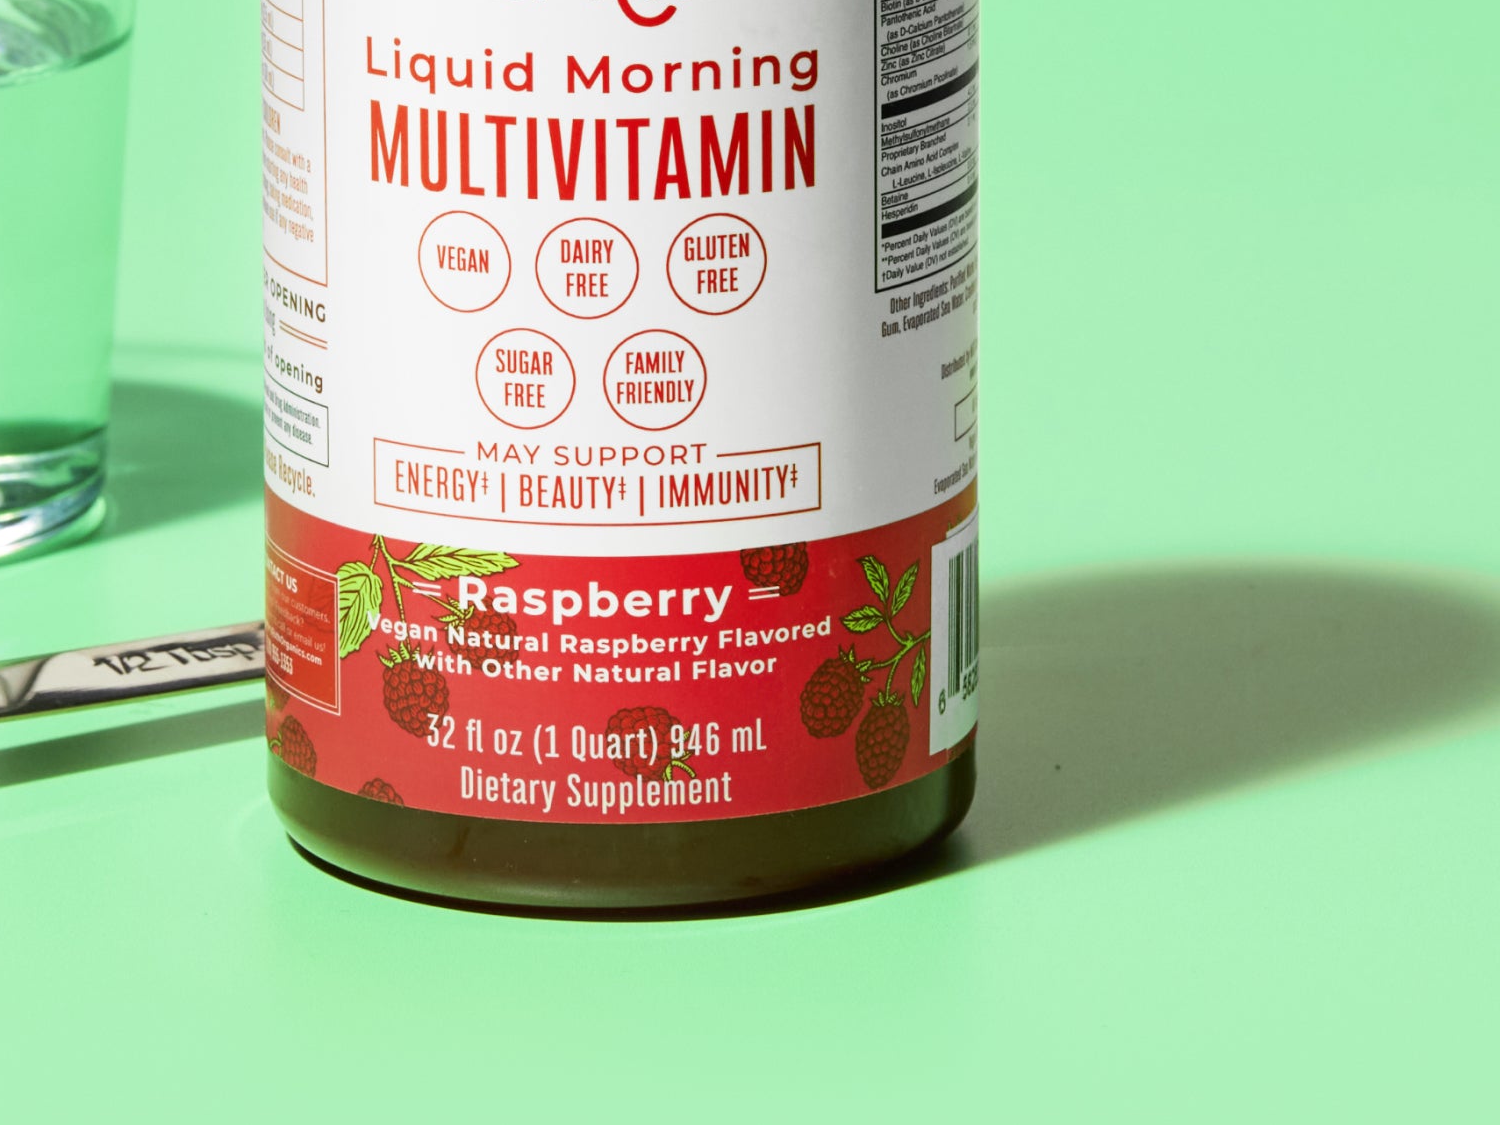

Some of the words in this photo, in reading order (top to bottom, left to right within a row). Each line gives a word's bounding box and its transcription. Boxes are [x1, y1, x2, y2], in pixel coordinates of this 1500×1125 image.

[881, 1, 901, 12] Biotin
[881, 10, 921, 27] Pantothenic
[881, 43, 908, 57] Choline
[910, 39, 920, 51] (as
[887, 31, 898, 42] (as
[365, 34, 534, 95] Liquid
[566, 45, 819, 95] Morning
[881, 60, 896, 71] Zinc
[899, 56, 910, 68] (as
[881, 69, 917, 86] Chromium
[887, 89, 898, 101] (as
[881, 118, 907, 132] Inositol
[369, 98, 817, 202] MULTIVITAMIN
[881, 145, 919, 161] Proprietary
[307, 159, 311, 173] a
[881, 163, 902, 177] Chain
[904, 157, 924, 171] Amino
[881, 193, 908, 206] Betaine
[881, 203, 918, 220] Hesperidin
[436, 244, 491, 274] VEGAN
[559, 238, 615, 265] DAIRY
[683, 232, 751, 262] GLUTEN
[696, 267, 739, 295] FREE
[905, 263, 924, 274] Value
[565, 273, 610, 298] FREE
[270, 277, 326, 323] OPENING
[890, 296, 911, 314] Other
[903, 303, 939, 331] Evaporated
[275, 354, 323, 394] opening
[495, 348, 554, 376] SUGAR
[625, 349, 686, 375] FAMILY
[504, 382, 546, 409] FREE
[616, 379, 695, 405] FRIENDLY
[477, 440, 541, 464] MAY
[553, 442, 708, 467] SUPPORT
[279, 455, 316, 498] Recycle.
[286, 574, 298, 594] US
[457, 575, 733, 625] Raspberry
[366, 610, 438, 642] Vegan
[446, 625, 549, 653] Natural
[560, 632, 709, 658] Raspberry
[718, 615, 832, 651] Flavored
[414, 652, 473, 676] with
[483, 657, 563, 683] Other
[572, 662, 682, 683] Natural
[691, 653, 778, 680] Flavor
[939, 688, 946, 715] 6
[426, 712, 456, 751] 32
[467, 720, 484, 755] fl
[494, 728, 523, 756] oz
[533, 723, 559, 765] (1
[571, 725, 660, 765] Quart)
[670, 723, 720, 757] 946
[732, 717, 767, 753] mL
[460, 765, 557, 814] Dietary
[567, 772, 732, 815] Supplement
